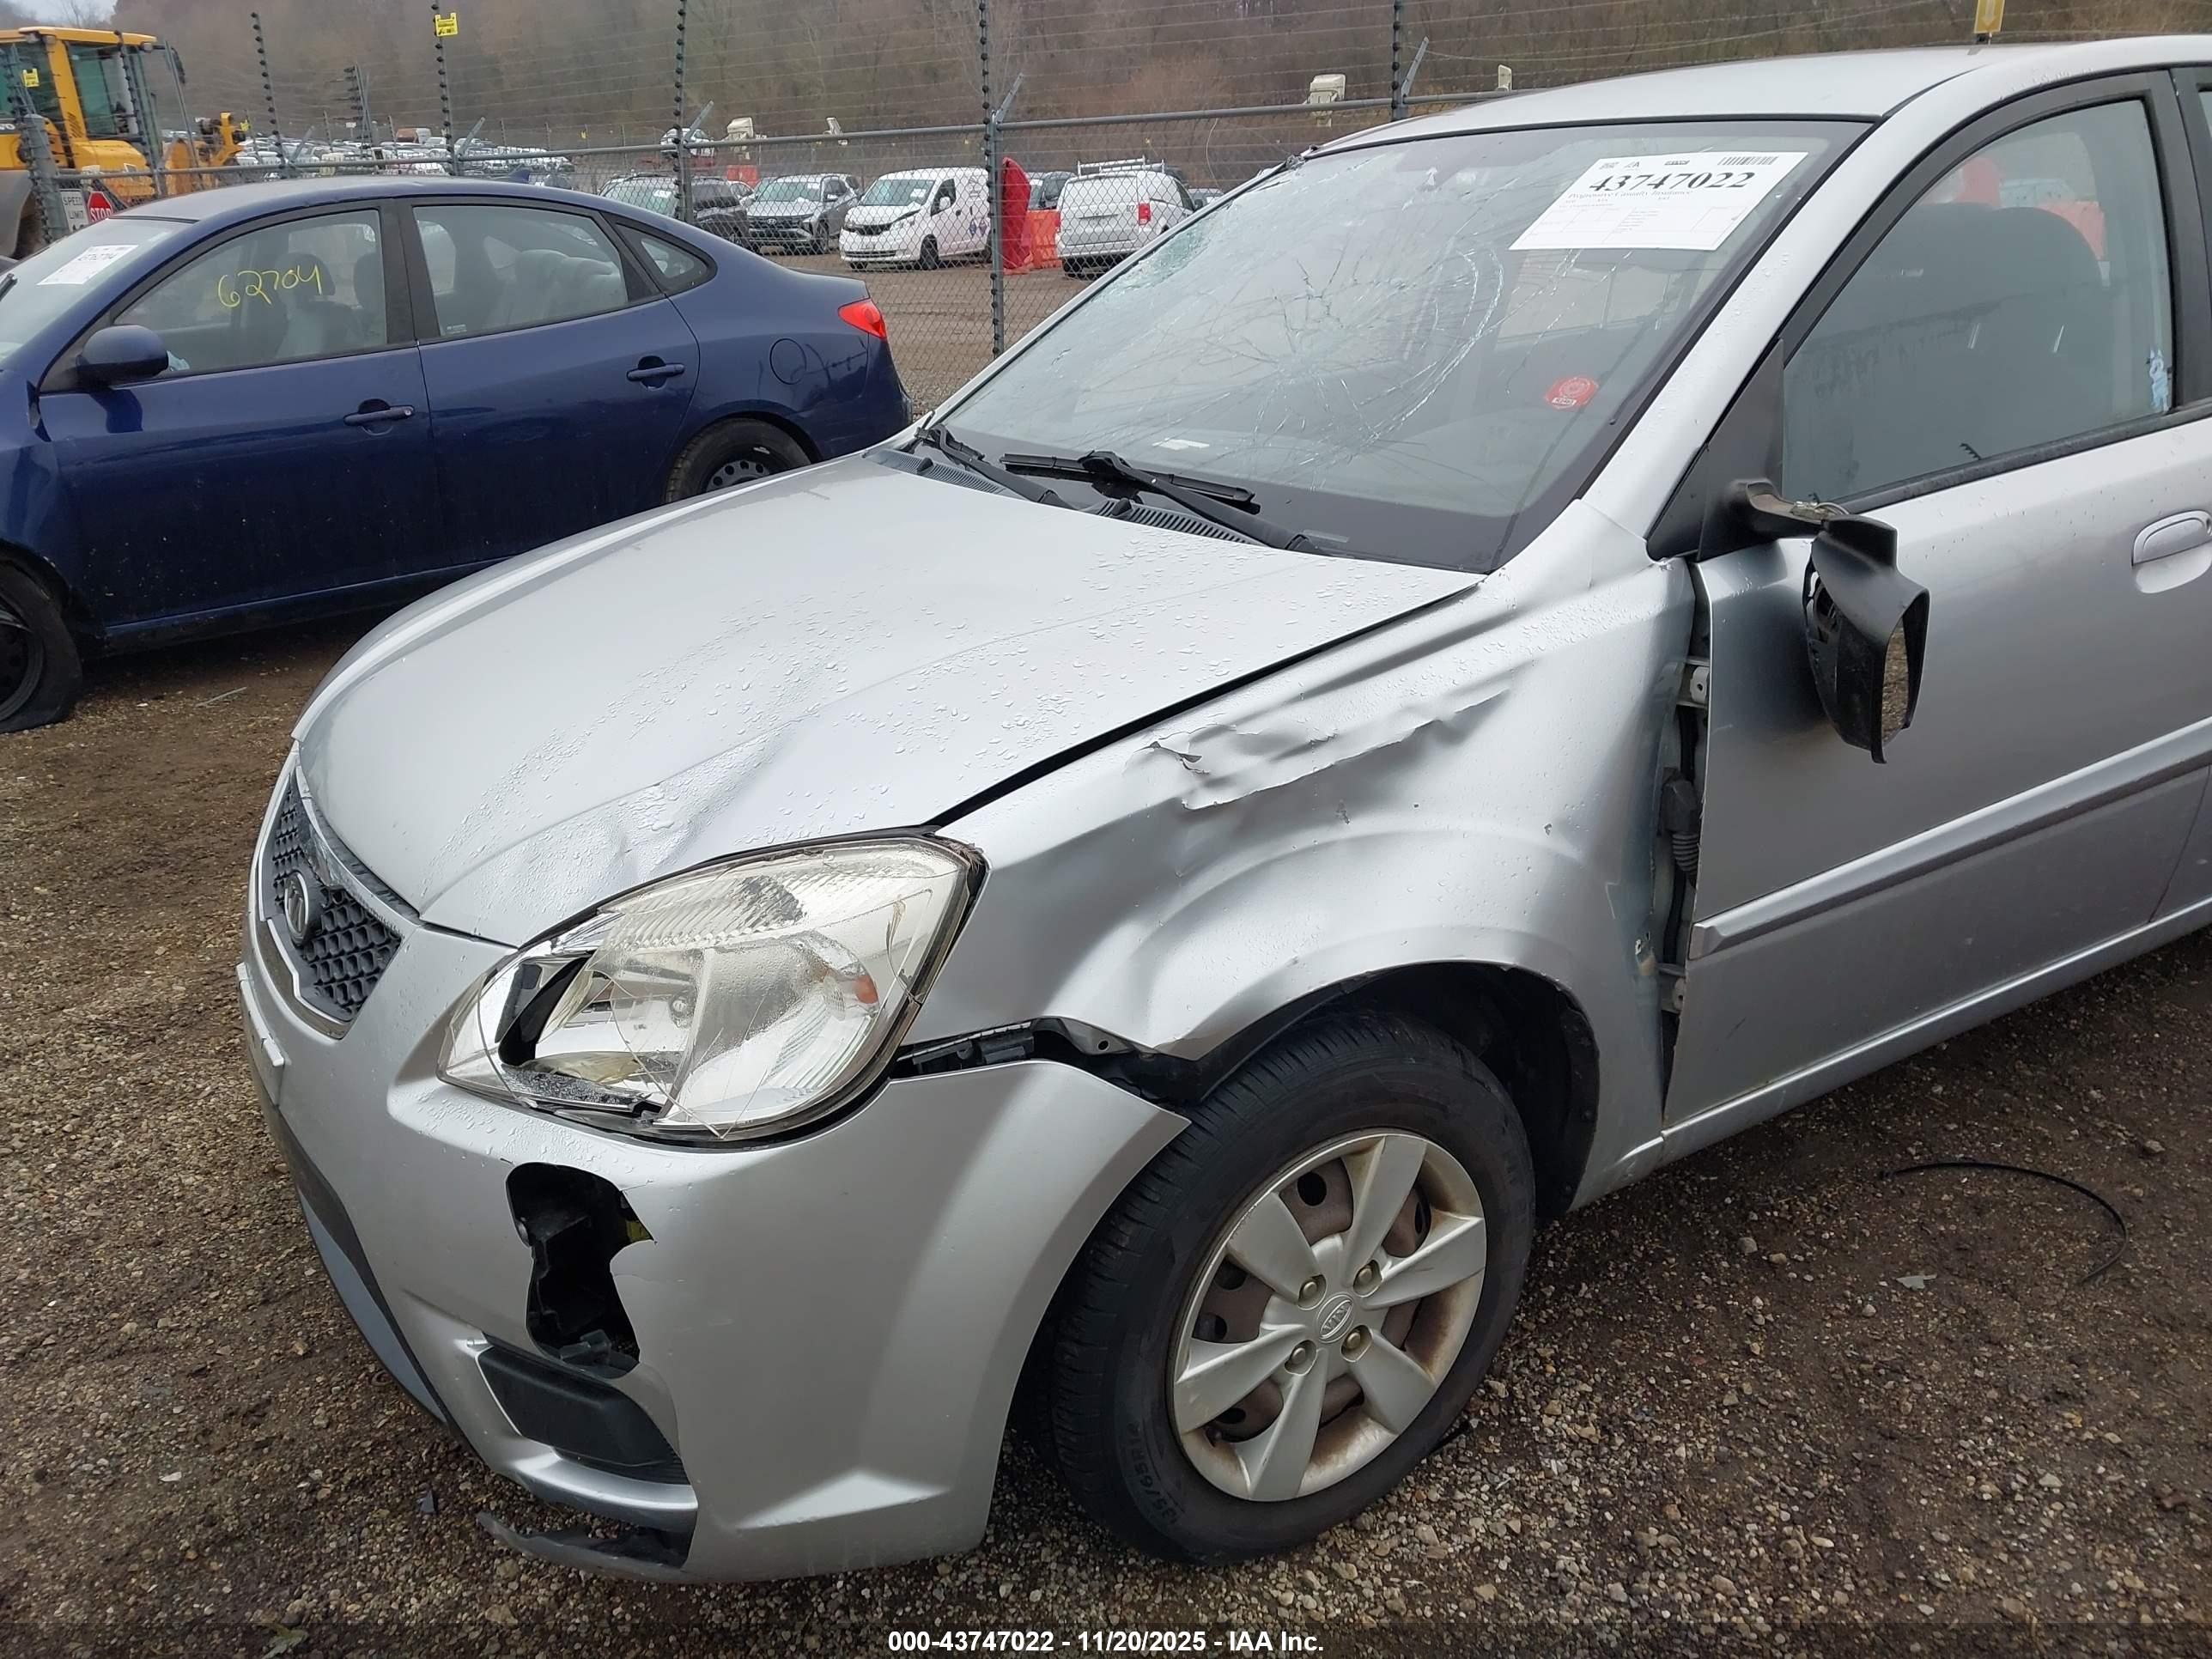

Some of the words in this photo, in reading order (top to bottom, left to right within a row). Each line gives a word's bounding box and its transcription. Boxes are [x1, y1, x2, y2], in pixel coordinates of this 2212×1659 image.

[1589, 172, 1756, 191] 43747022
[218, 264, 322, 307] 62704
[1323, 1303, 1350, 1332] KIA
